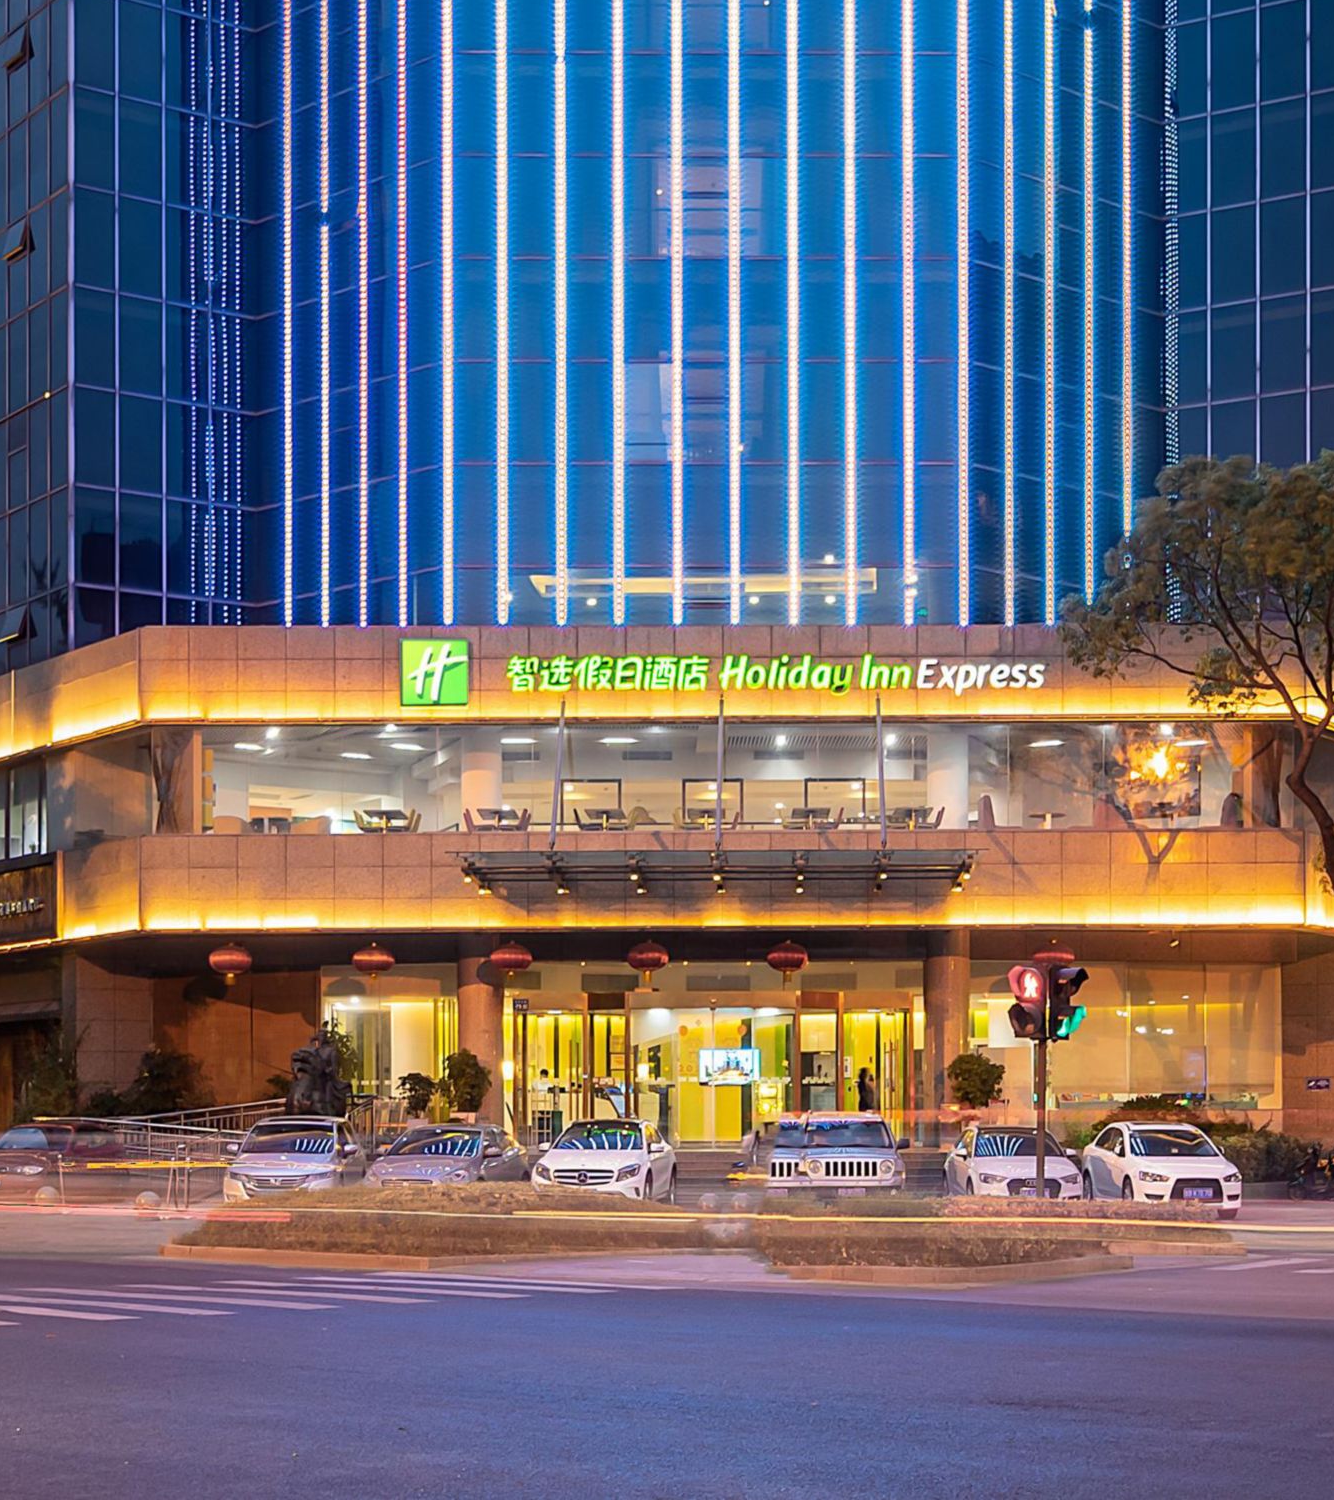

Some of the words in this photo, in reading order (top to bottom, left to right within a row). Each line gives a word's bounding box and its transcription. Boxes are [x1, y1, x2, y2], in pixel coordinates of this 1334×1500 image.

[505, 654, 710, 693] 智选假日酒店
[718, 653, 853, 697] Holiday
[915, 657, 1047, 697] Express
